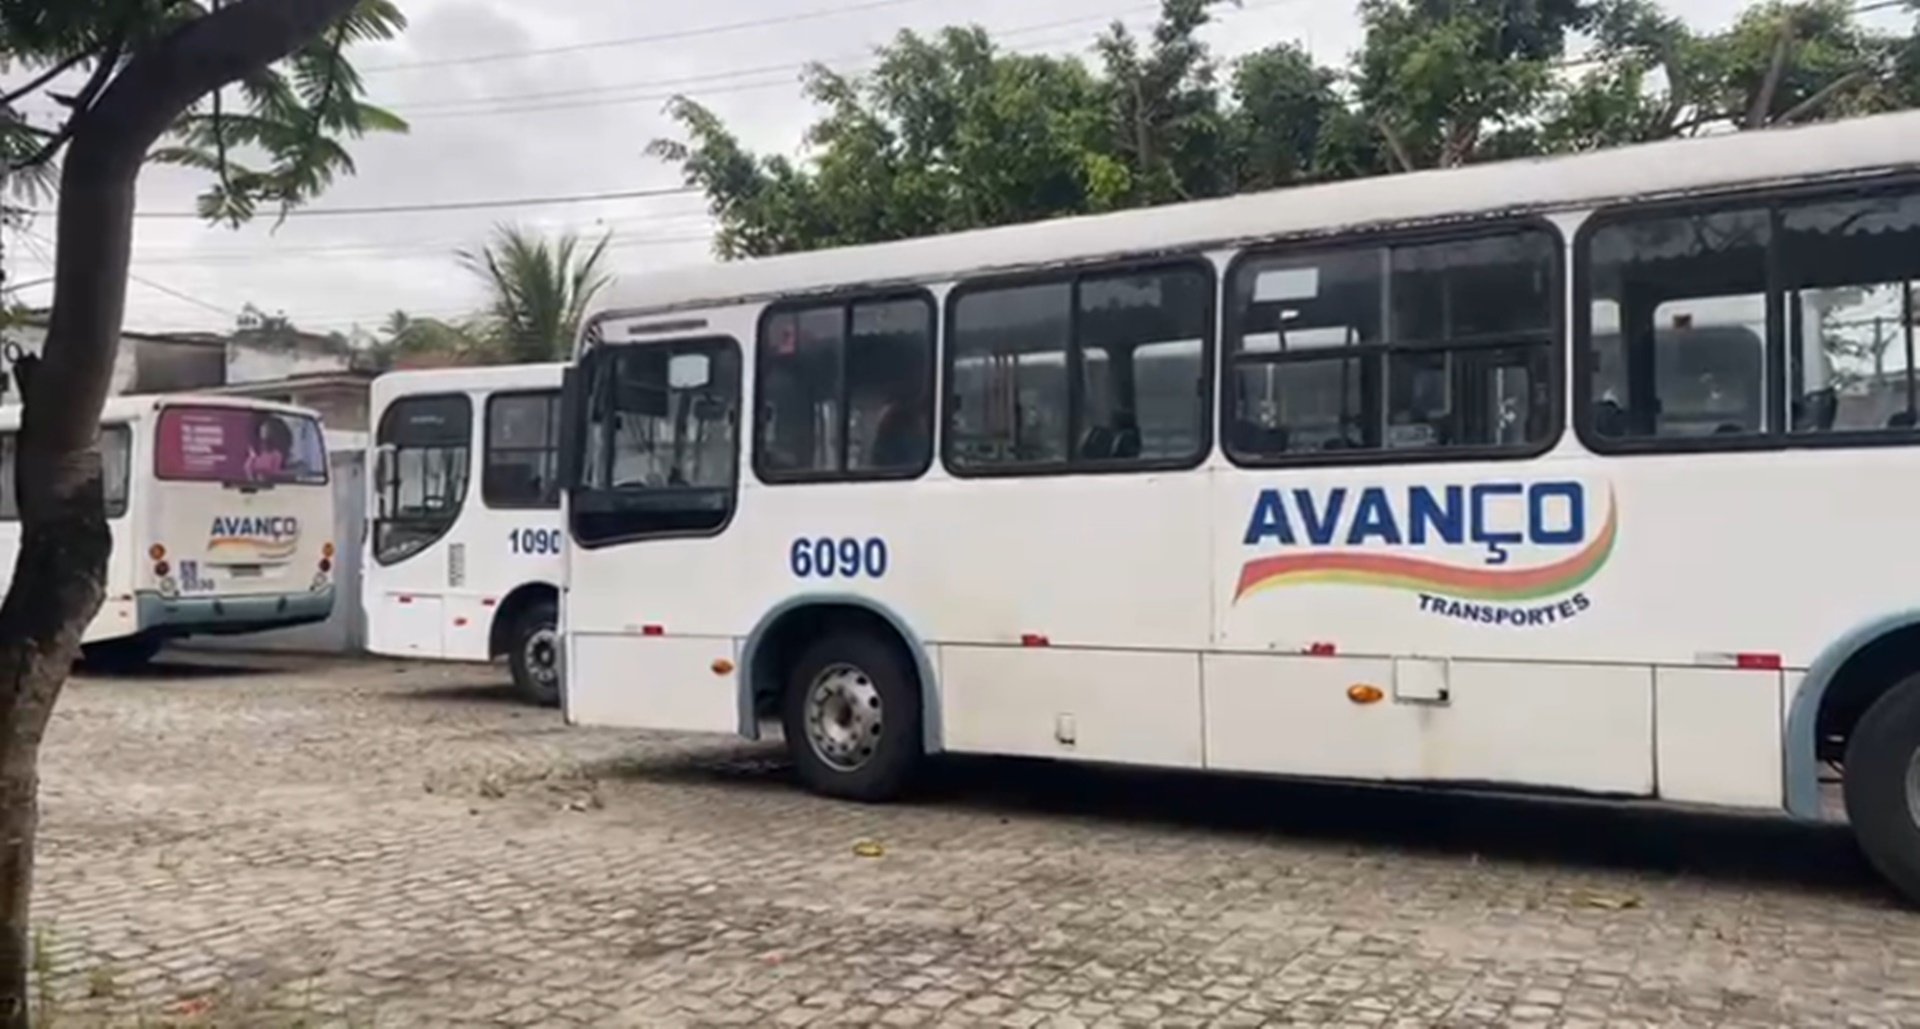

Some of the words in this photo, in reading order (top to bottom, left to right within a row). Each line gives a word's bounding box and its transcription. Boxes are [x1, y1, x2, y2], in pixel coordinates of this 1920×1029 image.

[211, 516, 297, 540] AVANÇO
[1243, 481, 1585, 564] AVANÇO
[791, 538, 887, 578] 6090
[1417, 593, 1591, 627] TRANSPORTES
